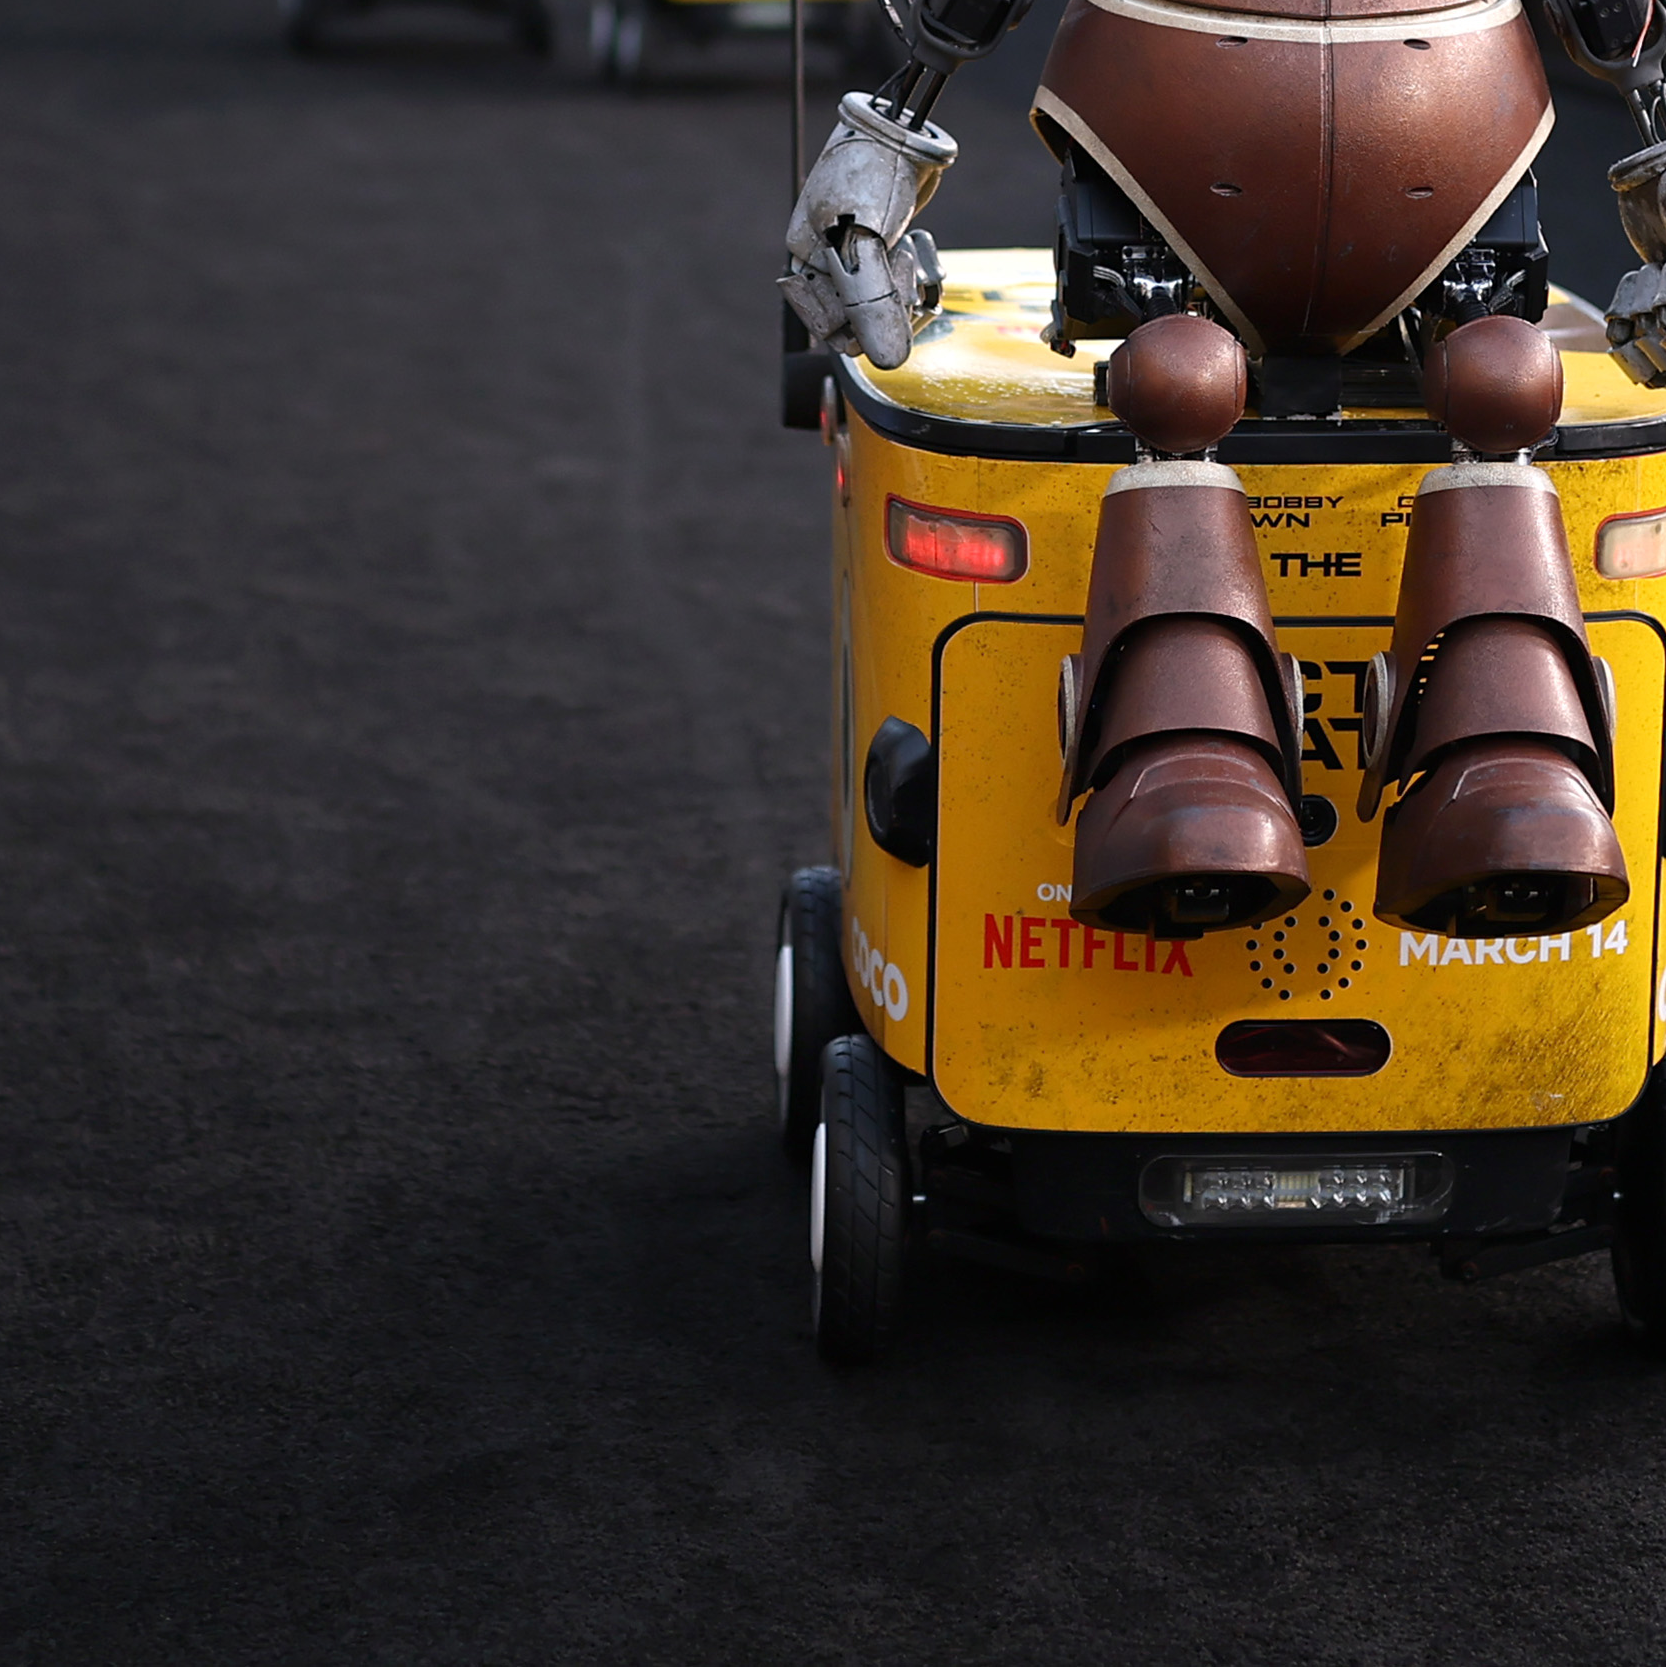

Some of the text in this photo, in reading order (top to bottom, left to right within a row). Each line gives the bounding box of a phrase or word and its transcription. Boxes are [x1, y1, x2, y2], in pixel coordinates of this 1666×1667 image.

[1247, 495, 1344, 509] BOBBY
[1270, 552, 1362, 578] THE
[1036, 883, 1072, 902] ON
[983, 912, 1194, 978] NETFLIX
[1399, 919, 1630, 967] MARCH 14
